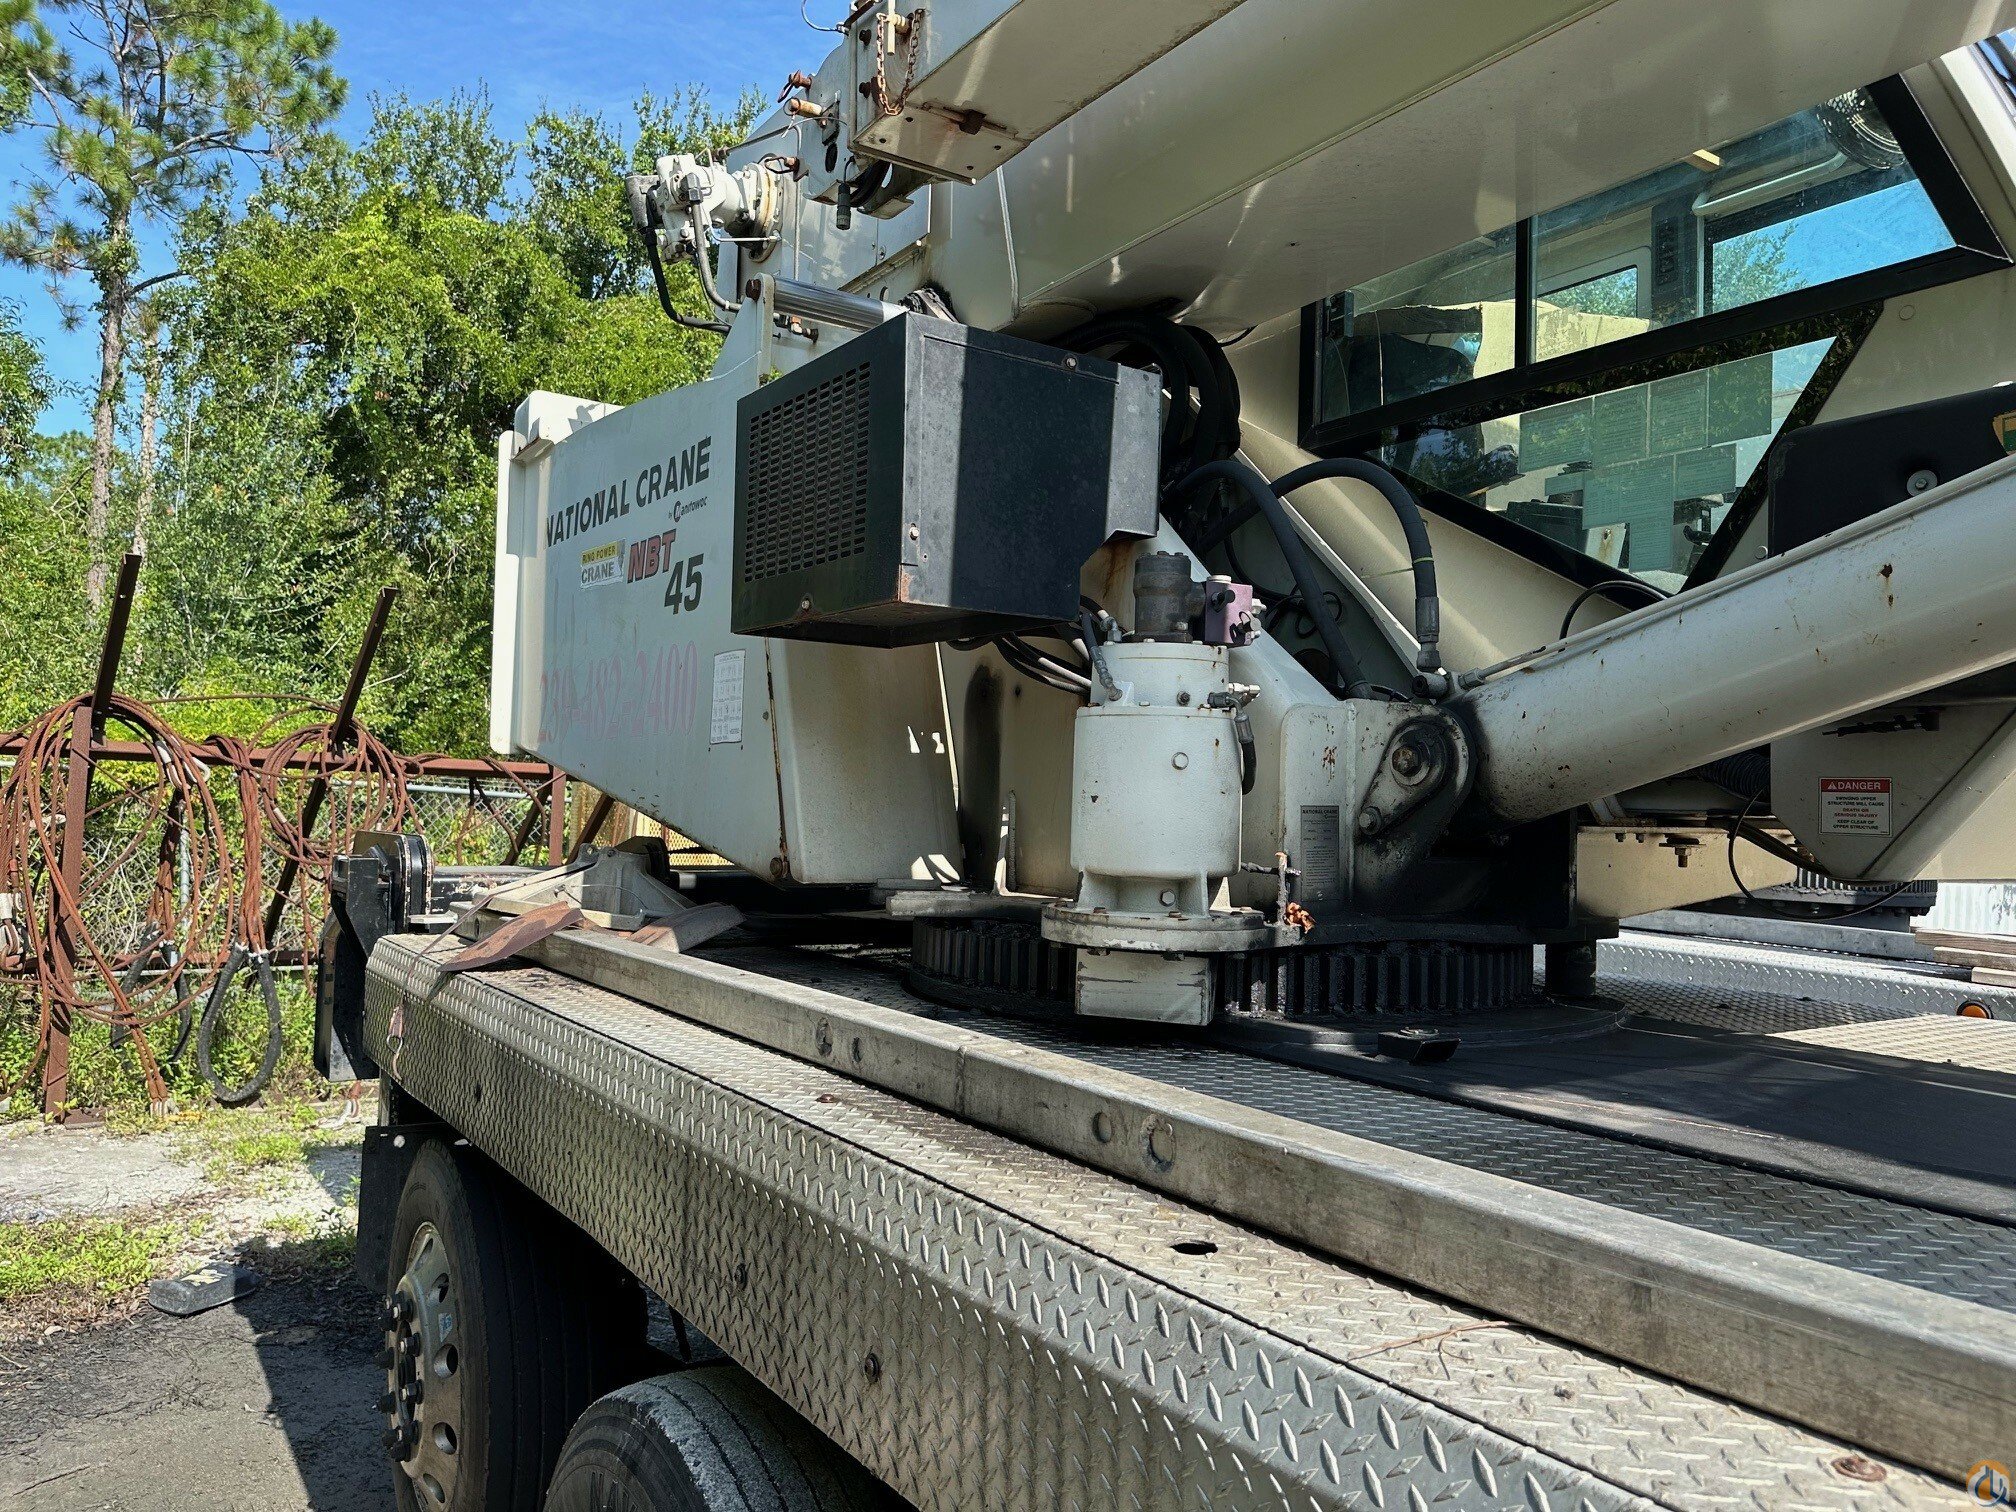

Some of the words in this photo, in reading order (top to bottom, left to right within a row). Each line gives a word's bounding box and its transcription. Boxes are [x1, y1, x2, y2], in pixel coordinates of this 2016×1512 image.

[546, 479, 630, 547] NATIONAL
[636, 436, 712, 508] CRANE
[596, 546, 616, 559] POWER
[627, 528, 677, 584] NBT
[581, 561, 615, 584] CRANE
[664, 553, 705, 615] 45
[1837, 781, 1881, 790] DANGER
